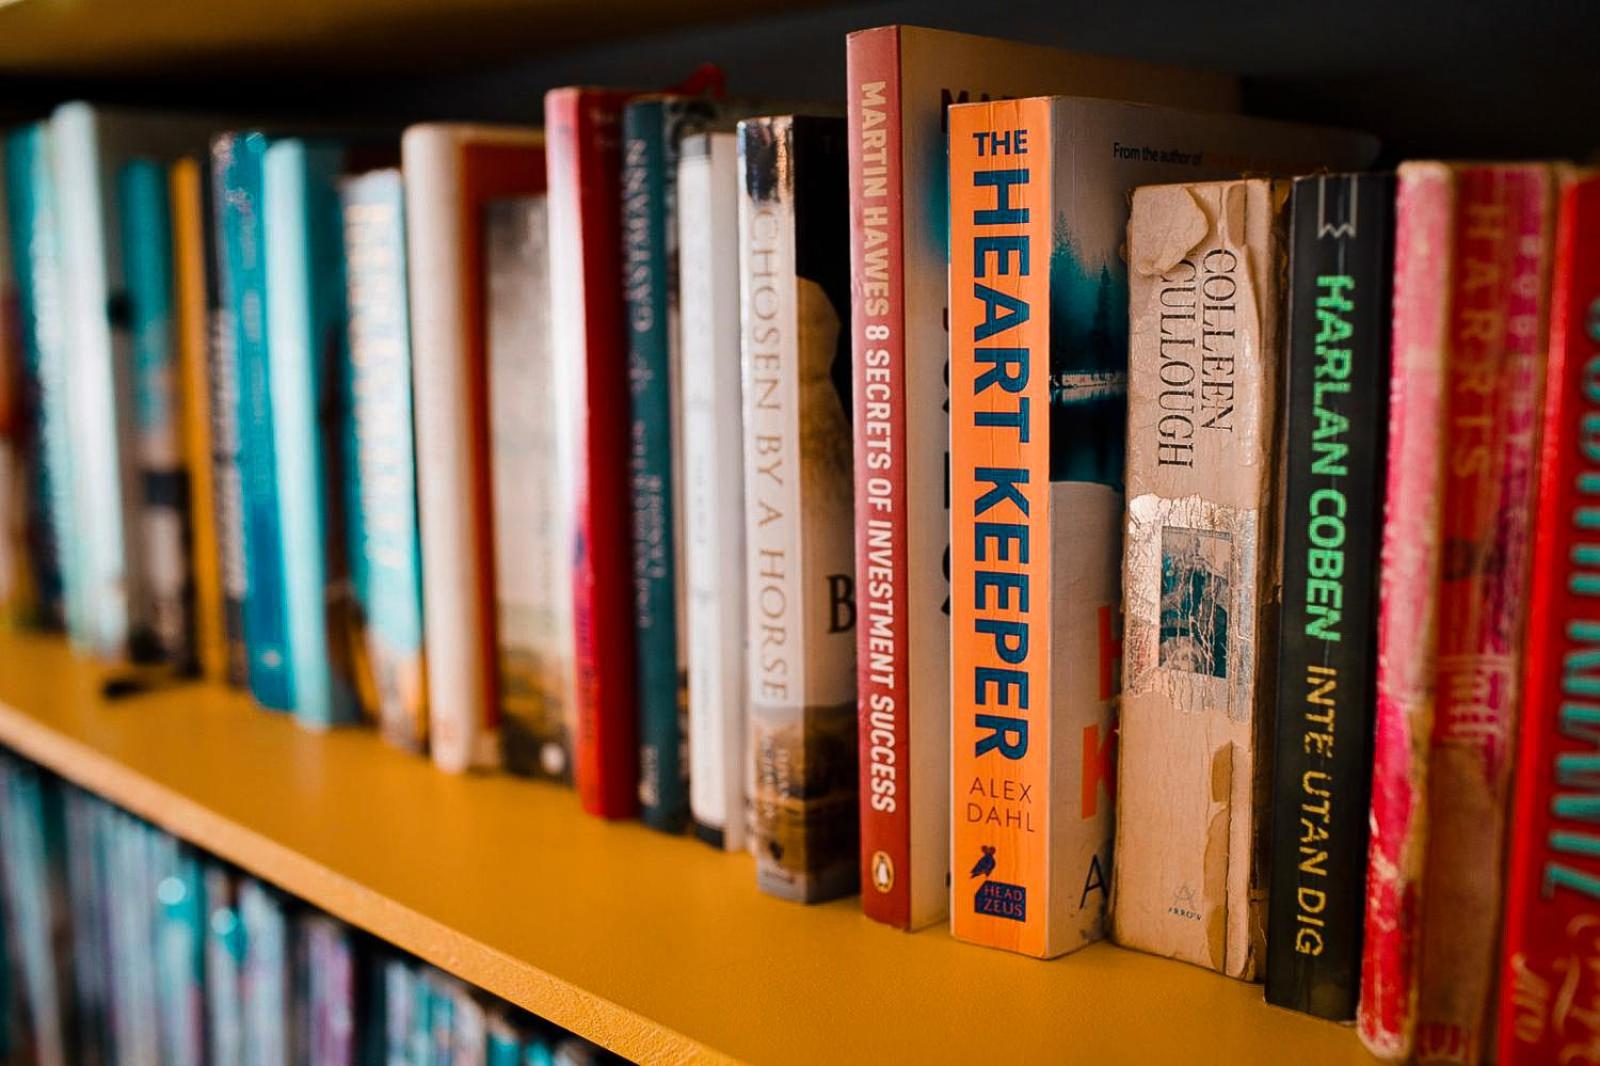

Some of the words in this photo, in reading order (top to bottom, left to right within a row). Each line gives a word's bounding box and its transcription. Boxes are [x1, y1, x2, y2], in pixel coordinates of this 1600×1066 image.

[861, 81, 889, 198] MARTIN
[972, 129, 1028, 156] THE
[1113, 142, 1141, 160] From
[1142, 145, 1159, 162] the
[749, 207, 781, 412] CHOSEN
[863, 207, 890, 316] HAWES
[973, 168, 1031, 443] HEART
[864, 324, 890, 341] 8
[1201, 248, 1238, 433] COLLEEN
[1311, 275, 1355, 477] HARLAN
[756, 435, 784, 488] BY
[864, 351, 893, 471] SECRETS
[757, 500, 784, 528] A
[868, 477, 893, 513] OF
[867, 519, 897, 689] INVESTMENT
[973, 466, 1031, 761] KEEPER
[1305, 487, 1347, 642] COBEN
[758, 548, 789, 701] HORSE
[869, 693, 898, 814] SUCCESS
[1304, 664, 1337, 759] INTE
[966, 802, 1036, 833] DAHL
[969, 776, 1033, 804] ALEX
[1299, 769, 1331, 877] UTAN
[983, 884, 1023, 902] HEAD
[983, 897, 1023, 917] ZEUS
[1295, 886, 1327, 957] DIG
